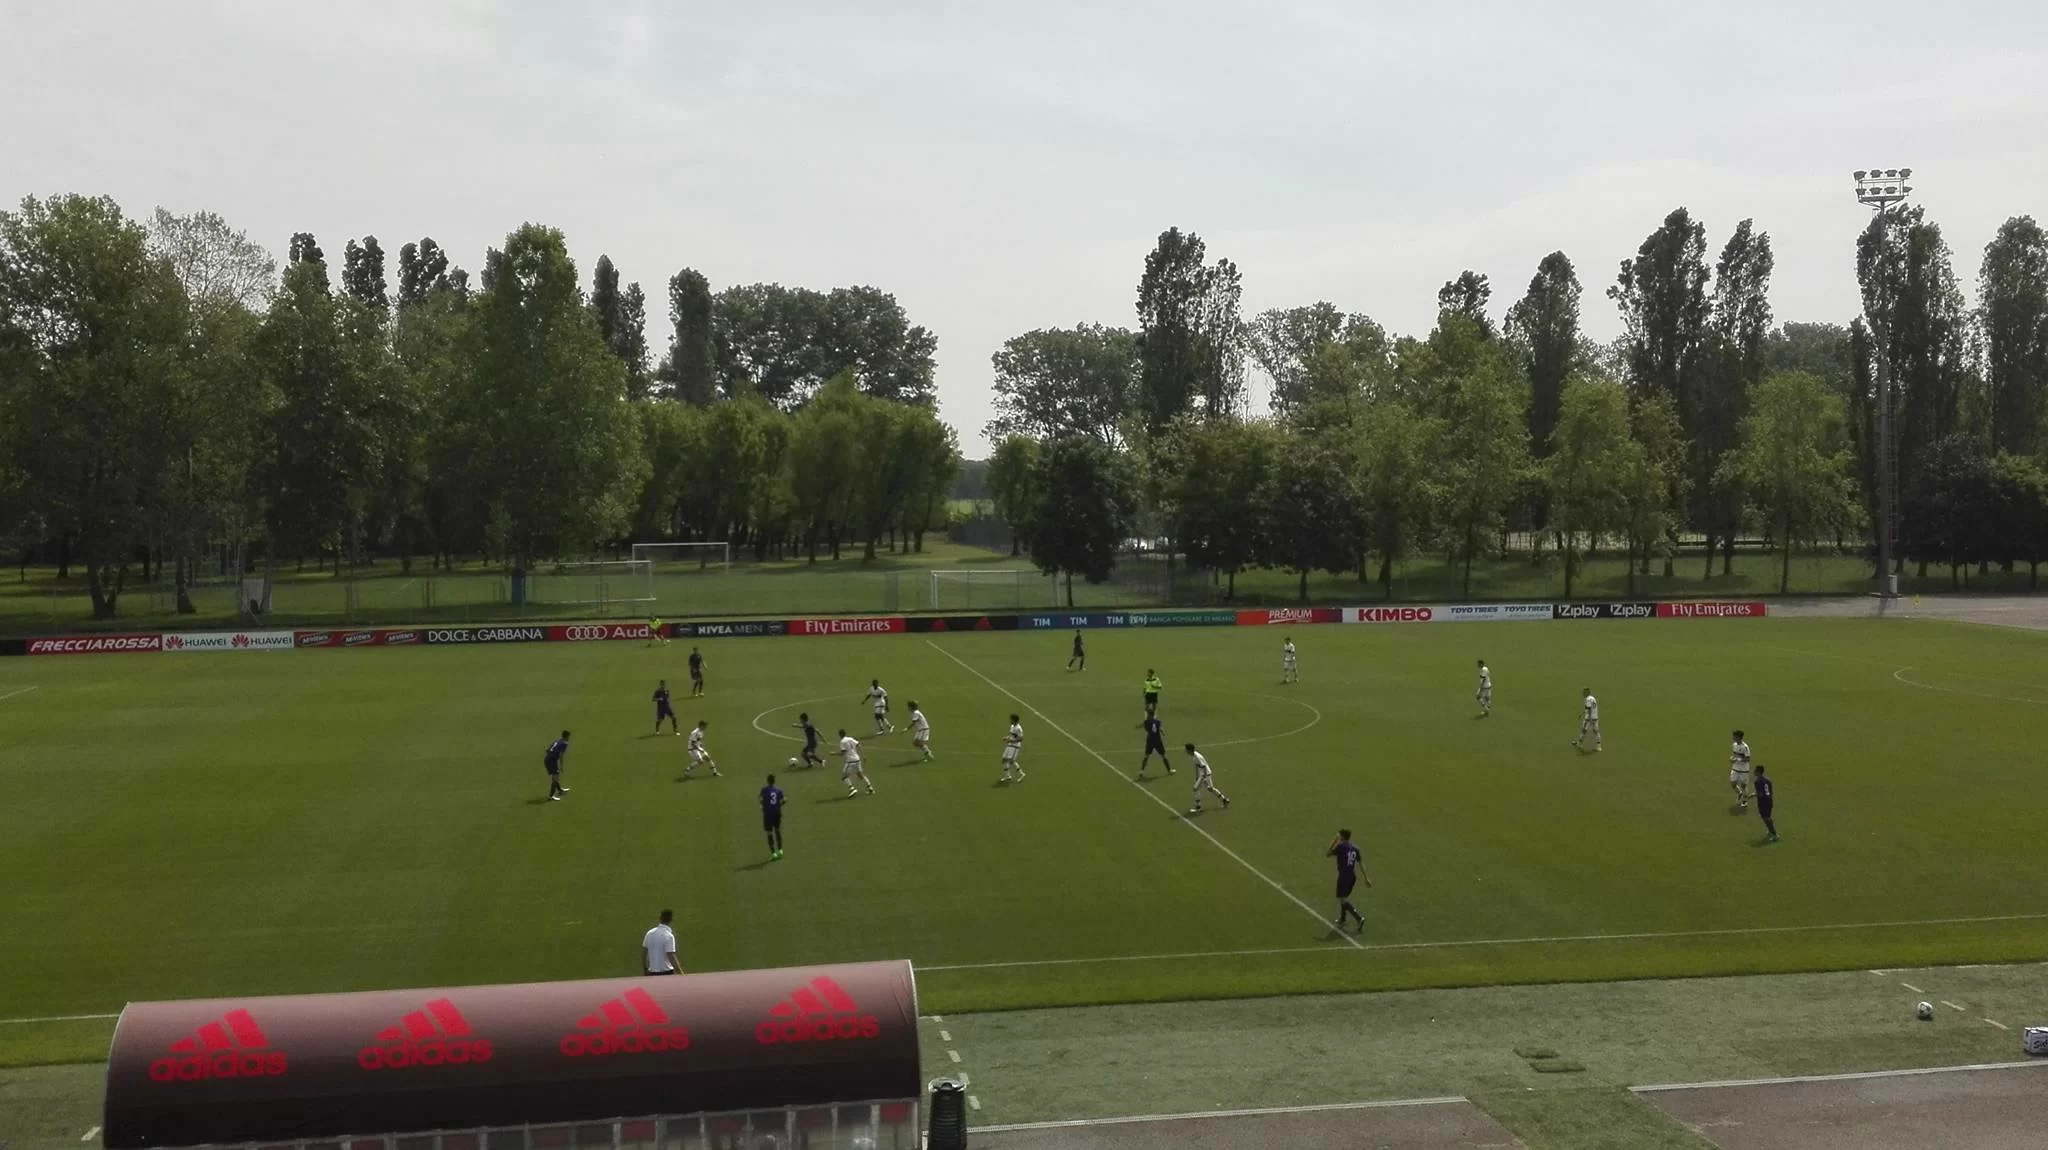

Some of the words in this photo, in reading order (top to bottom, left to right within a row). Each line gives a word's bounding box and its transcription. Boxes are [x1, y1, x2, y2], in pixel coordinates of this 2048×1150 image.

[1268, 608, 1313, 619] PREMIUM
[1358, 607, 1432, 622] KIMBO
[1671, 604, 1692, 618] Fly
[1695, 602, 1751, 616] Emirates
[805, 620, 829, 635] Fly
[831, 619, 890, 633] Emirates
[1032, 617, 1051, 627] TIM
[1069, 616, 1087, 626] TIM
[1106, 615, 1124, 625] TIM
[428, 630, 469, 642] DOLCE
[477, 628, 543, 641] GABBANA
[612, 626, 650, 639] Aud
[698, 624, 733, 635] NIVEA
[734, 624, 763, 634] MEN
[30, 636, 160, 653] FRECCIAROSSA
[185, 637, 227, 648] HUAWEI
[250, 637, 293, 647] HUAWEI
[770, 791, 777, 805] 3
[756, 1009, 879, 1045] adidas
[560, 1021, 689, 1057] adidas
[358, 1035, 493, 1071] adidas
[150, 1045, 287, 1083] adidas
